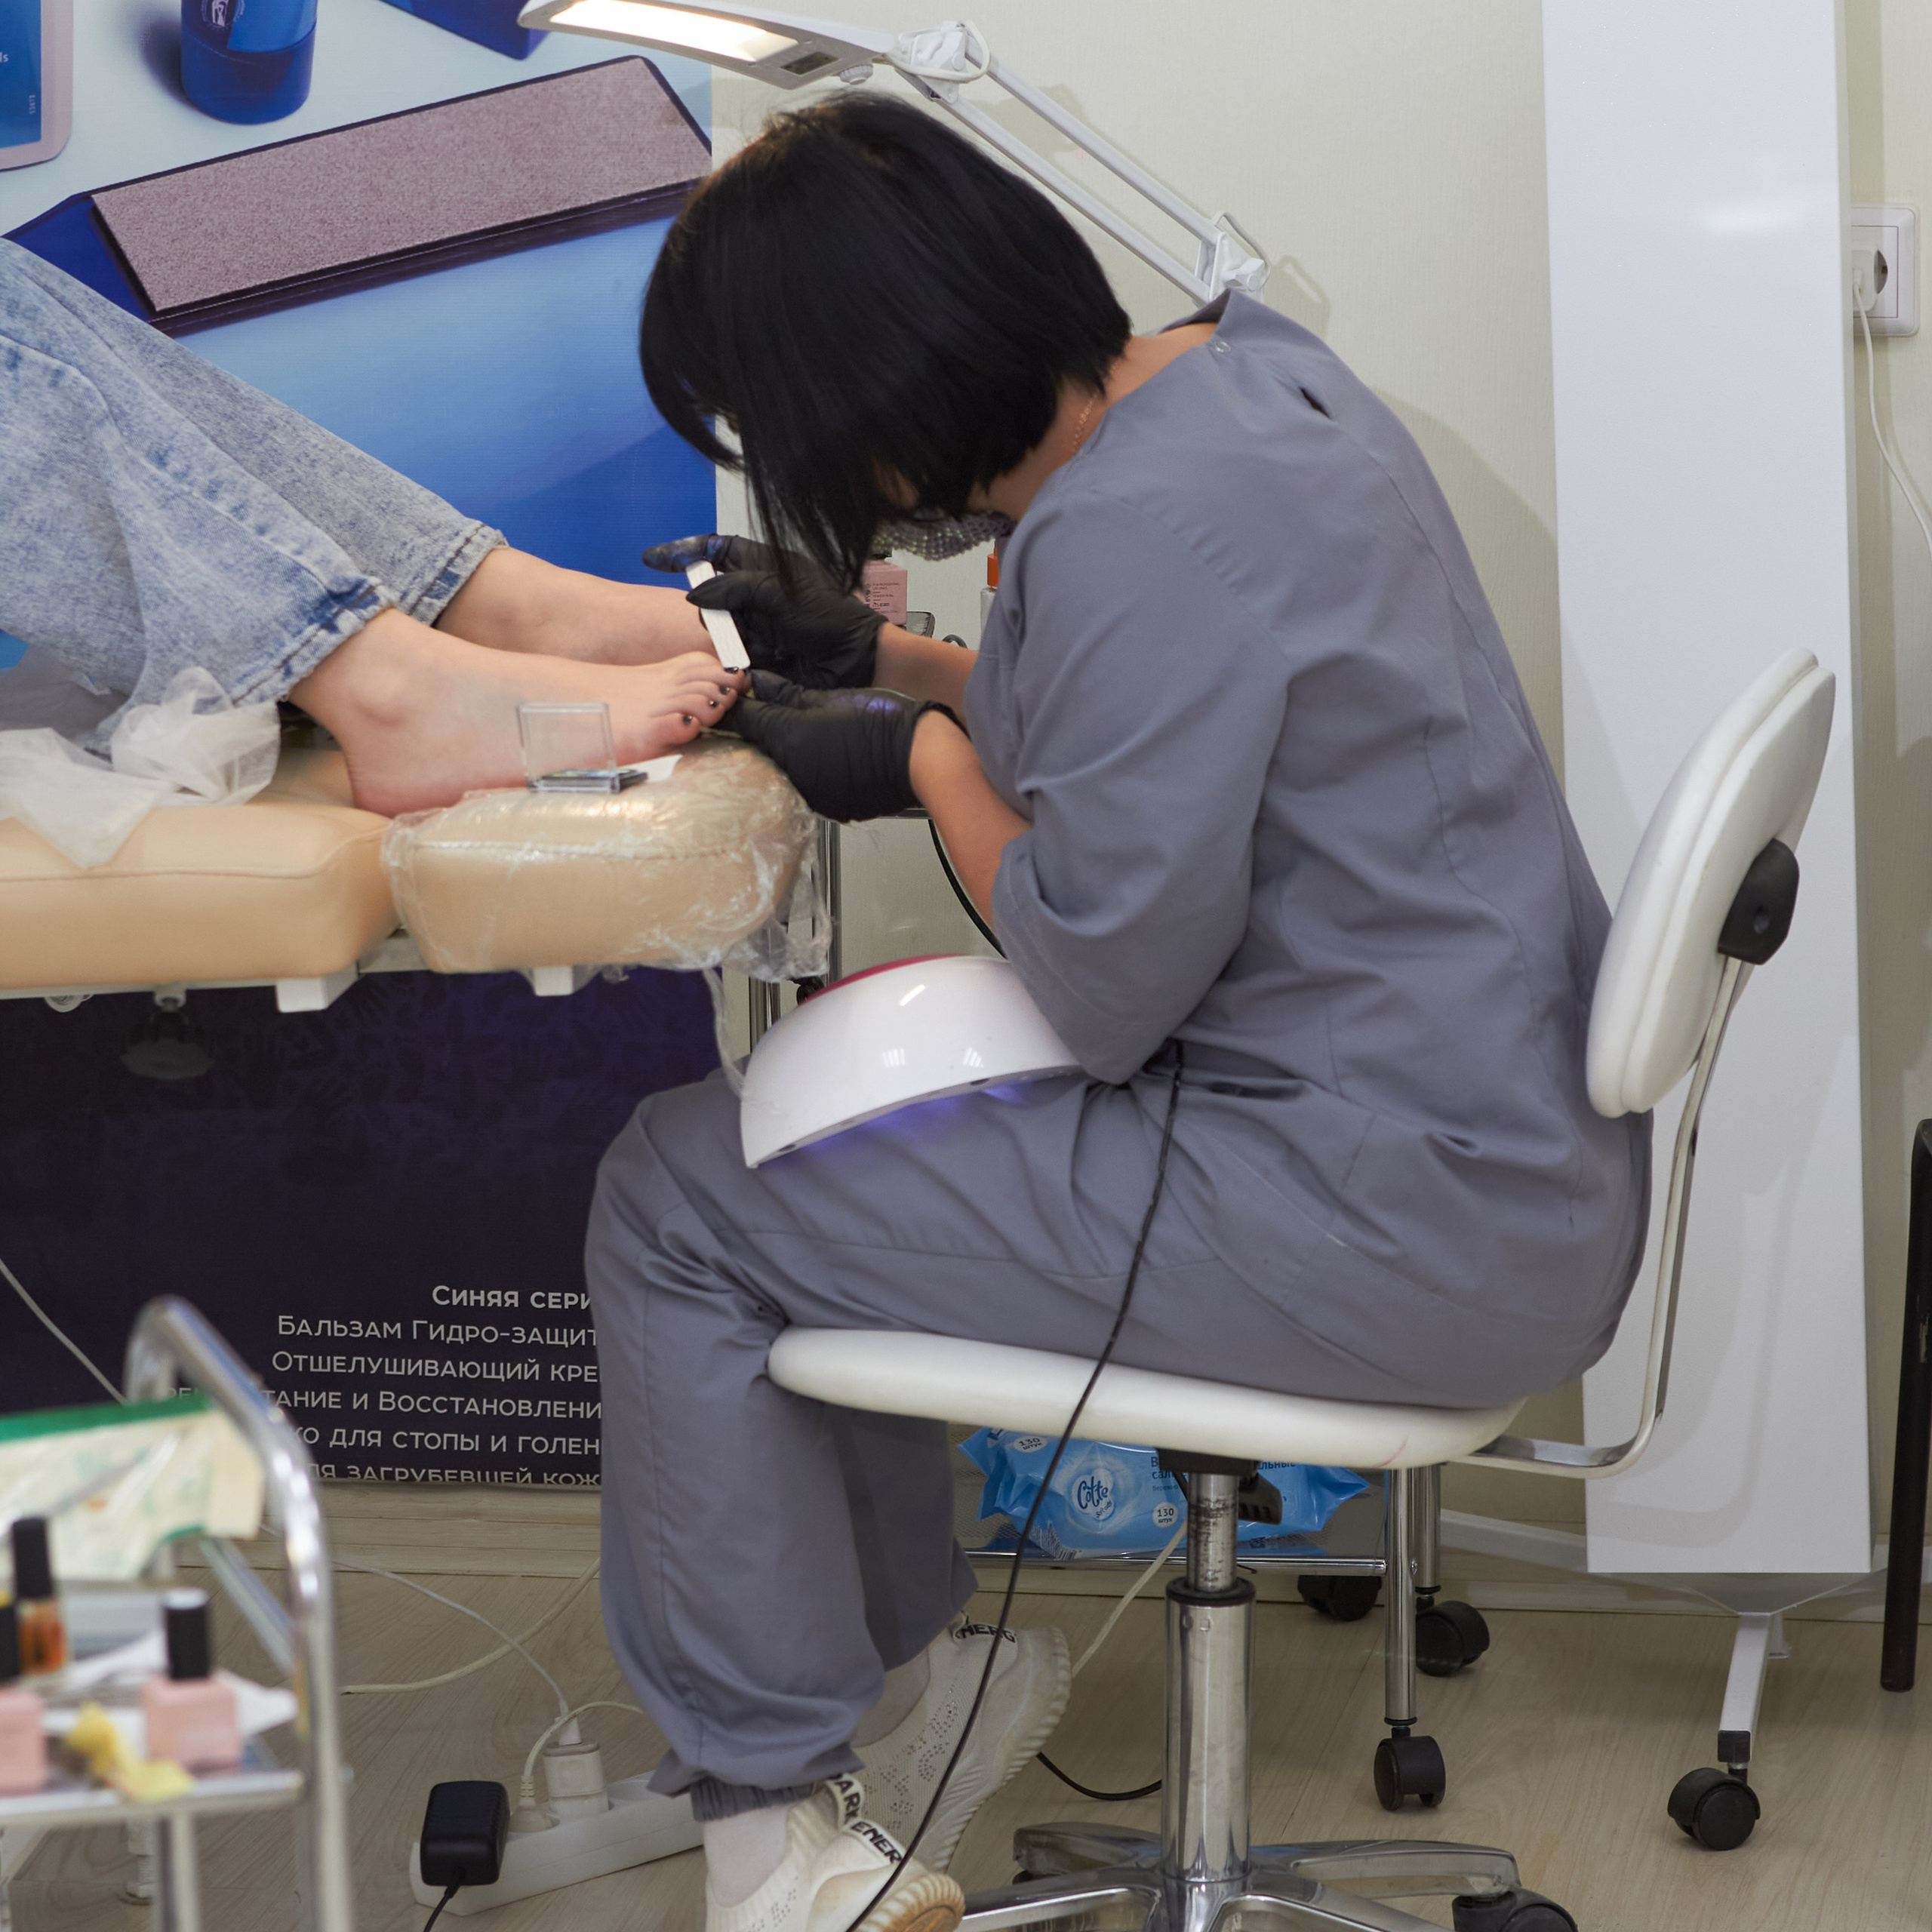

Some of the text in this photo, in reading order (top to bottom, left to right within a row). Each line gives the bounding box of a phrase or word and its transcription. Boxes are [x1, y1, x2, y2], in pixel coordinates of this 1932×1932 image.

[432, 1285, 519, 1308] СИНЯЯ
[278, 1315, 401, 1339] БАЛЬЗАМ
[272, 1350, 602, 1383] ОТШЕЛУШИВАЮЩИЙ КРЕ
[352, 1392, 368, 1411] И
[379, 1390, 601, 1419] ВОССТАНОВЛЕНИ
[329, 1428, 382, 1449] ДЛЯ
[392, 1431, 479, 1452] СТОПЫ
[491, 1435, 506, 1453] И
[518, 1435, 603, 1456] ГОЛЕН
[1077, 1475, 1109, 1510] Cotte
[1157, 1508, 1174, 1518] 130
